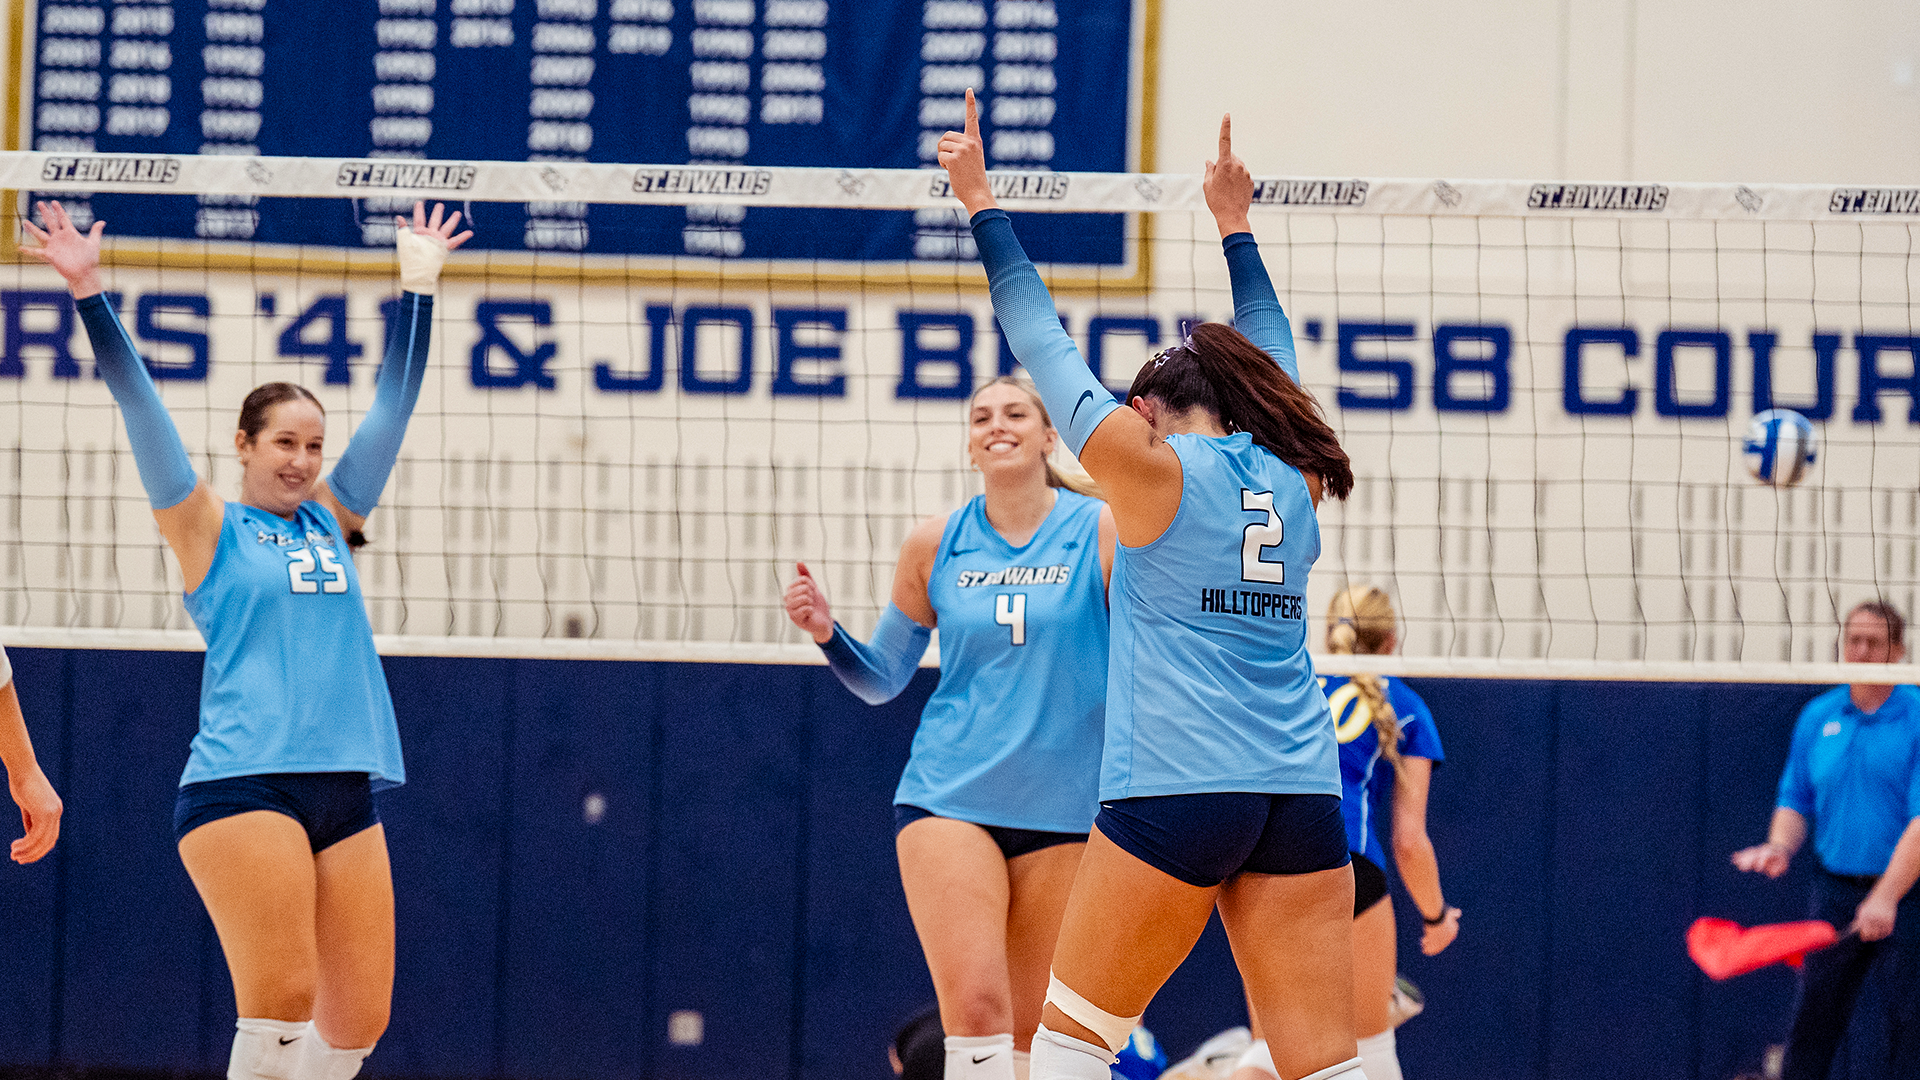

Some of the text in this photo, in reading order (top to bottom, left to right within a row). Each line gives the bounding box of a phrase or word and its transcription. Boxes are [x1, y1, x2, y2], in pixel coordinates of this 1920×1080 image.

[470, 300, 556, 389] &
[593, 304, 848, 397] JOE
[1304, 319, 1513, 412] '58
[1240, 487, 1284, 584] 2
[285, 545, 348, 595] 25
[995, 593, 1027, 646] 4
[1201, 587, 1302, 620] HILLTOPPERS
